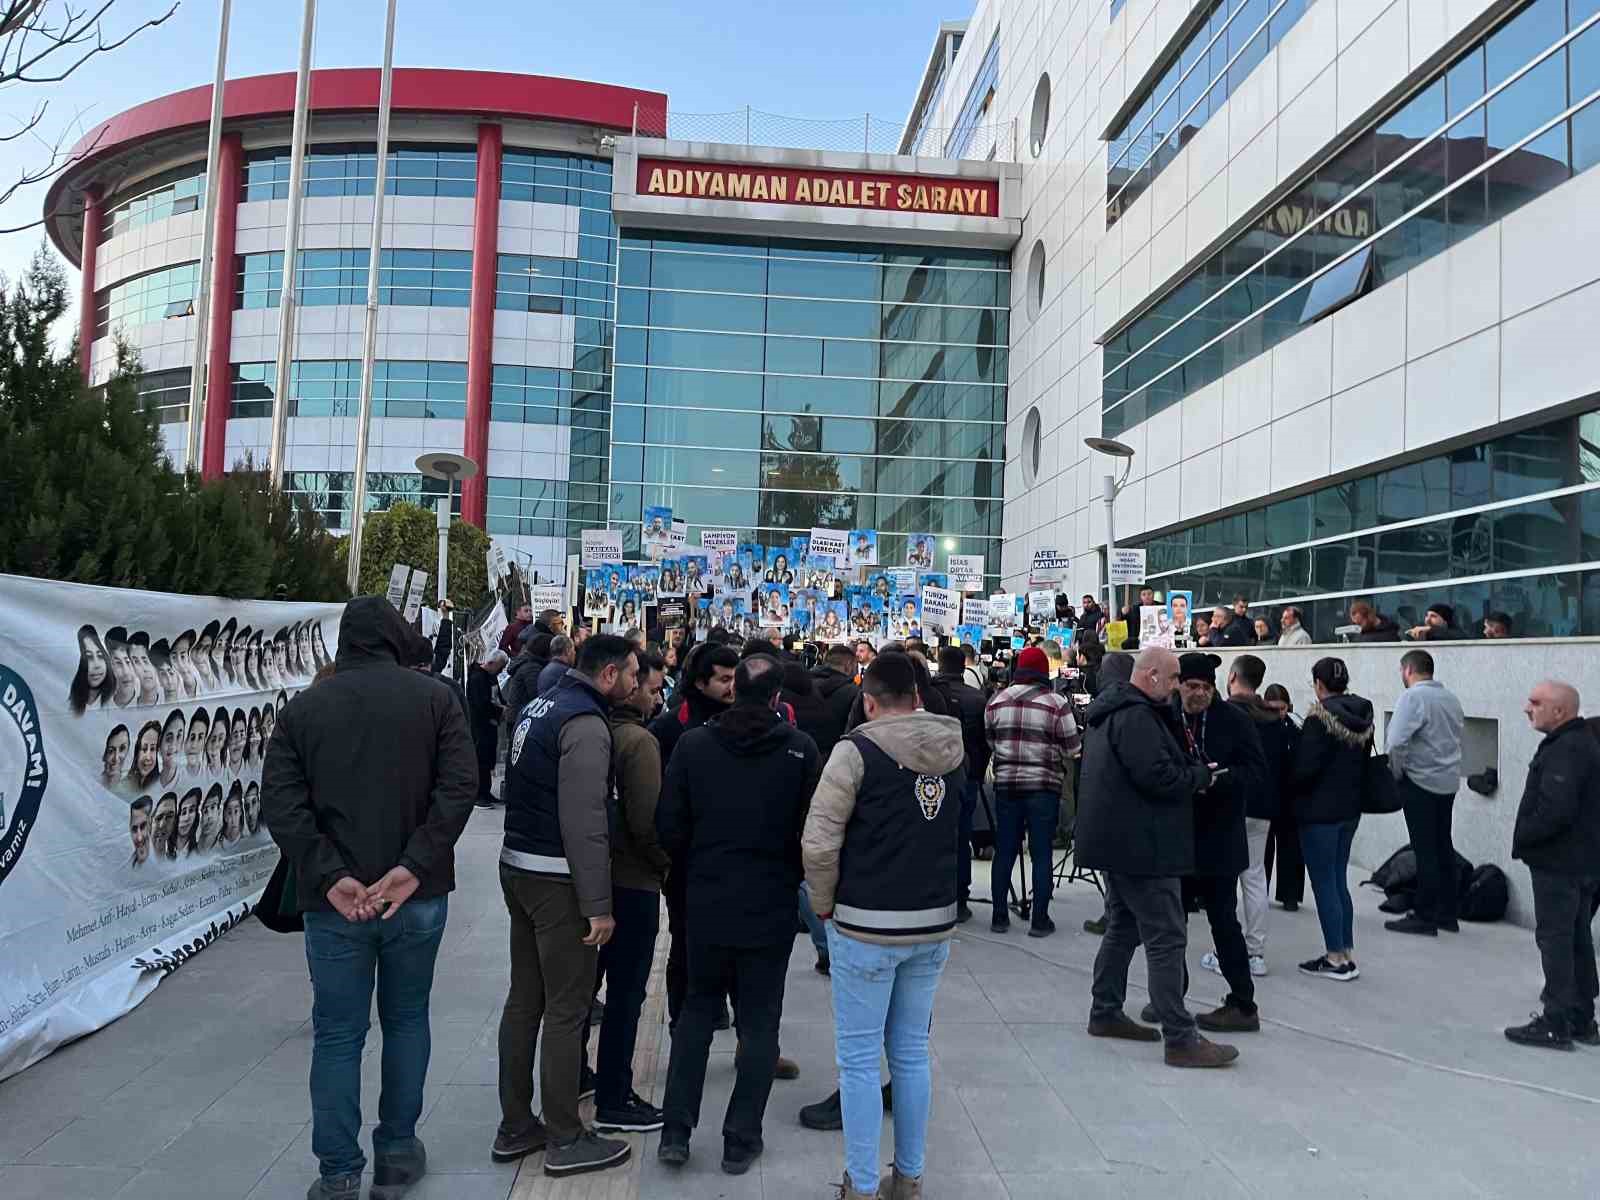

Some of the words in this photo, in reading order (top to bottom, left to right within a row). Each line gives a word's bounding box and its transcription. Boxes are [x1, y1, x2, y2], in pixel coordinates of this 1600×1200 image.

[648, 168, 787, 201] ADIYAMAN
[795, 178, 891, 207] ADALET
[897, 184, 988, 214] SARAYI
[1034, 551, 1057, 559] AFET
